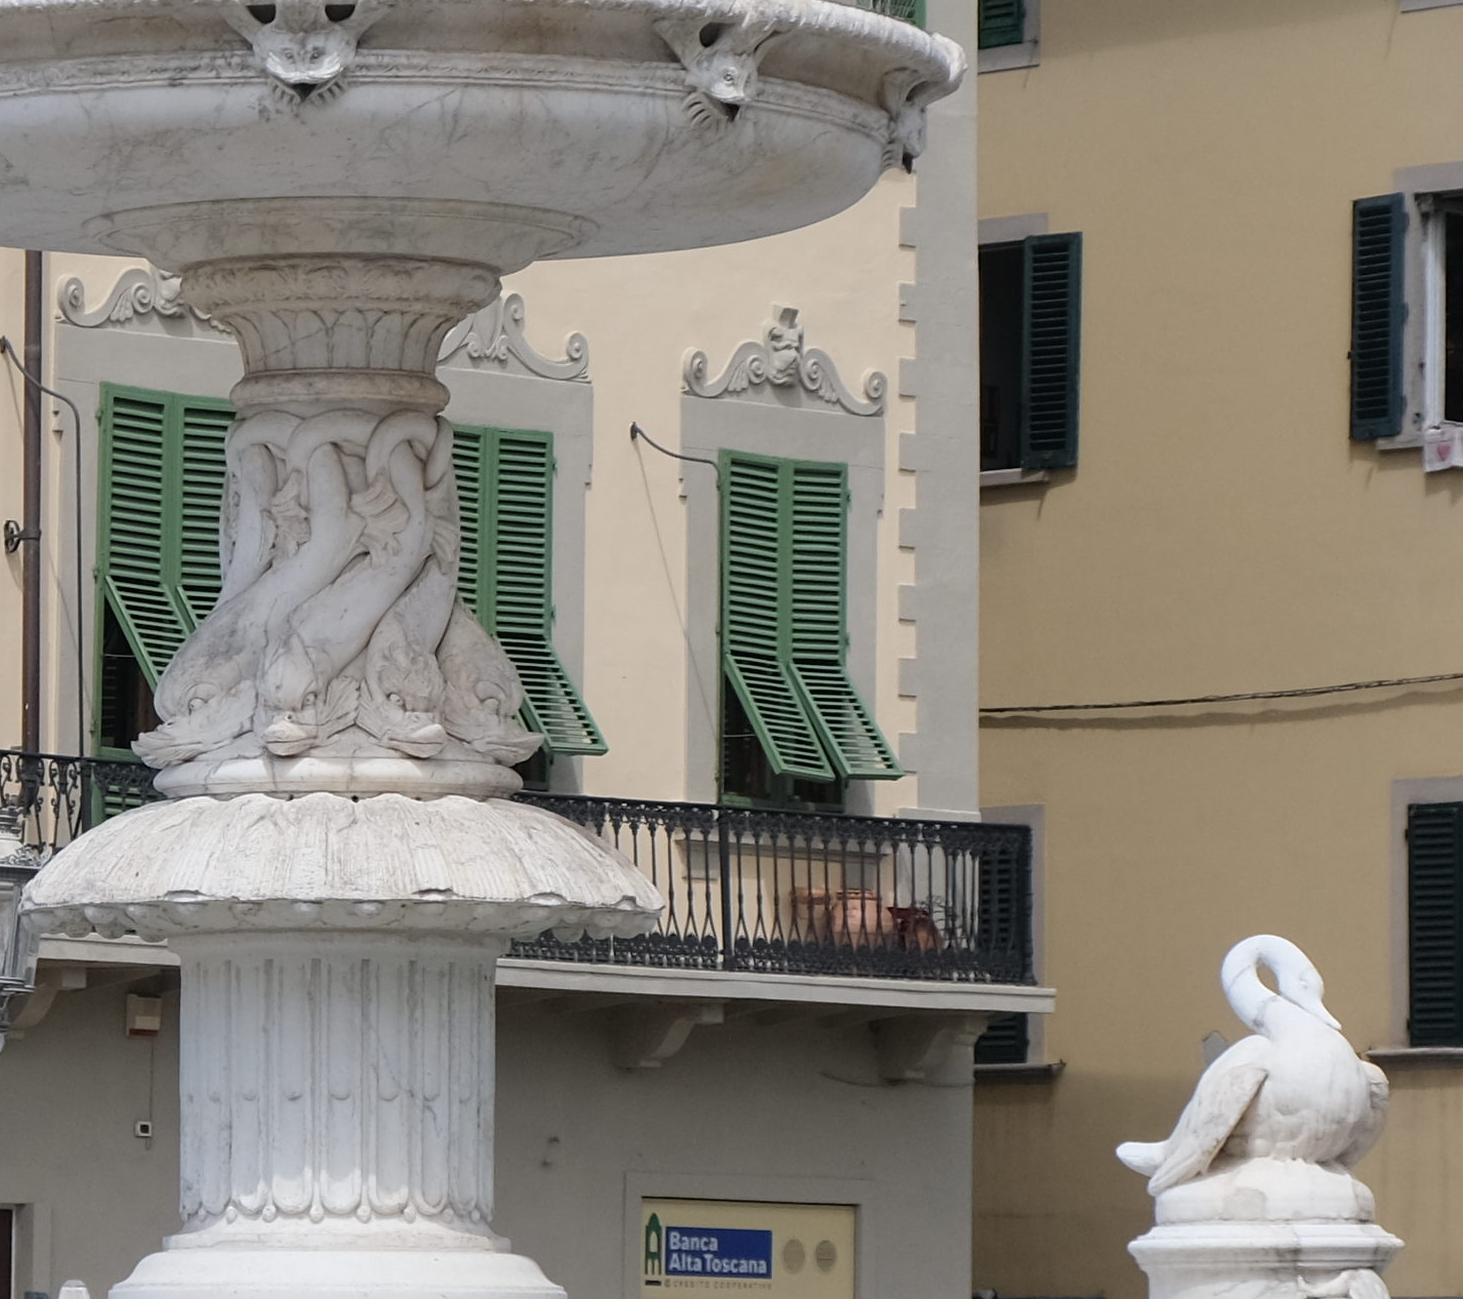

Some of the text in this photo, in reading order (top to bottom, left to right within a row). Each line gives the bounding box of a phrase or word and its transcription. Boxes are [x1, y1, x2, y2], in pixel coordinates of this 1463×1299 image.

[669, 1231, 718, 1251] Banca
[668, 1253, 768, 1274] Alta Toscana
